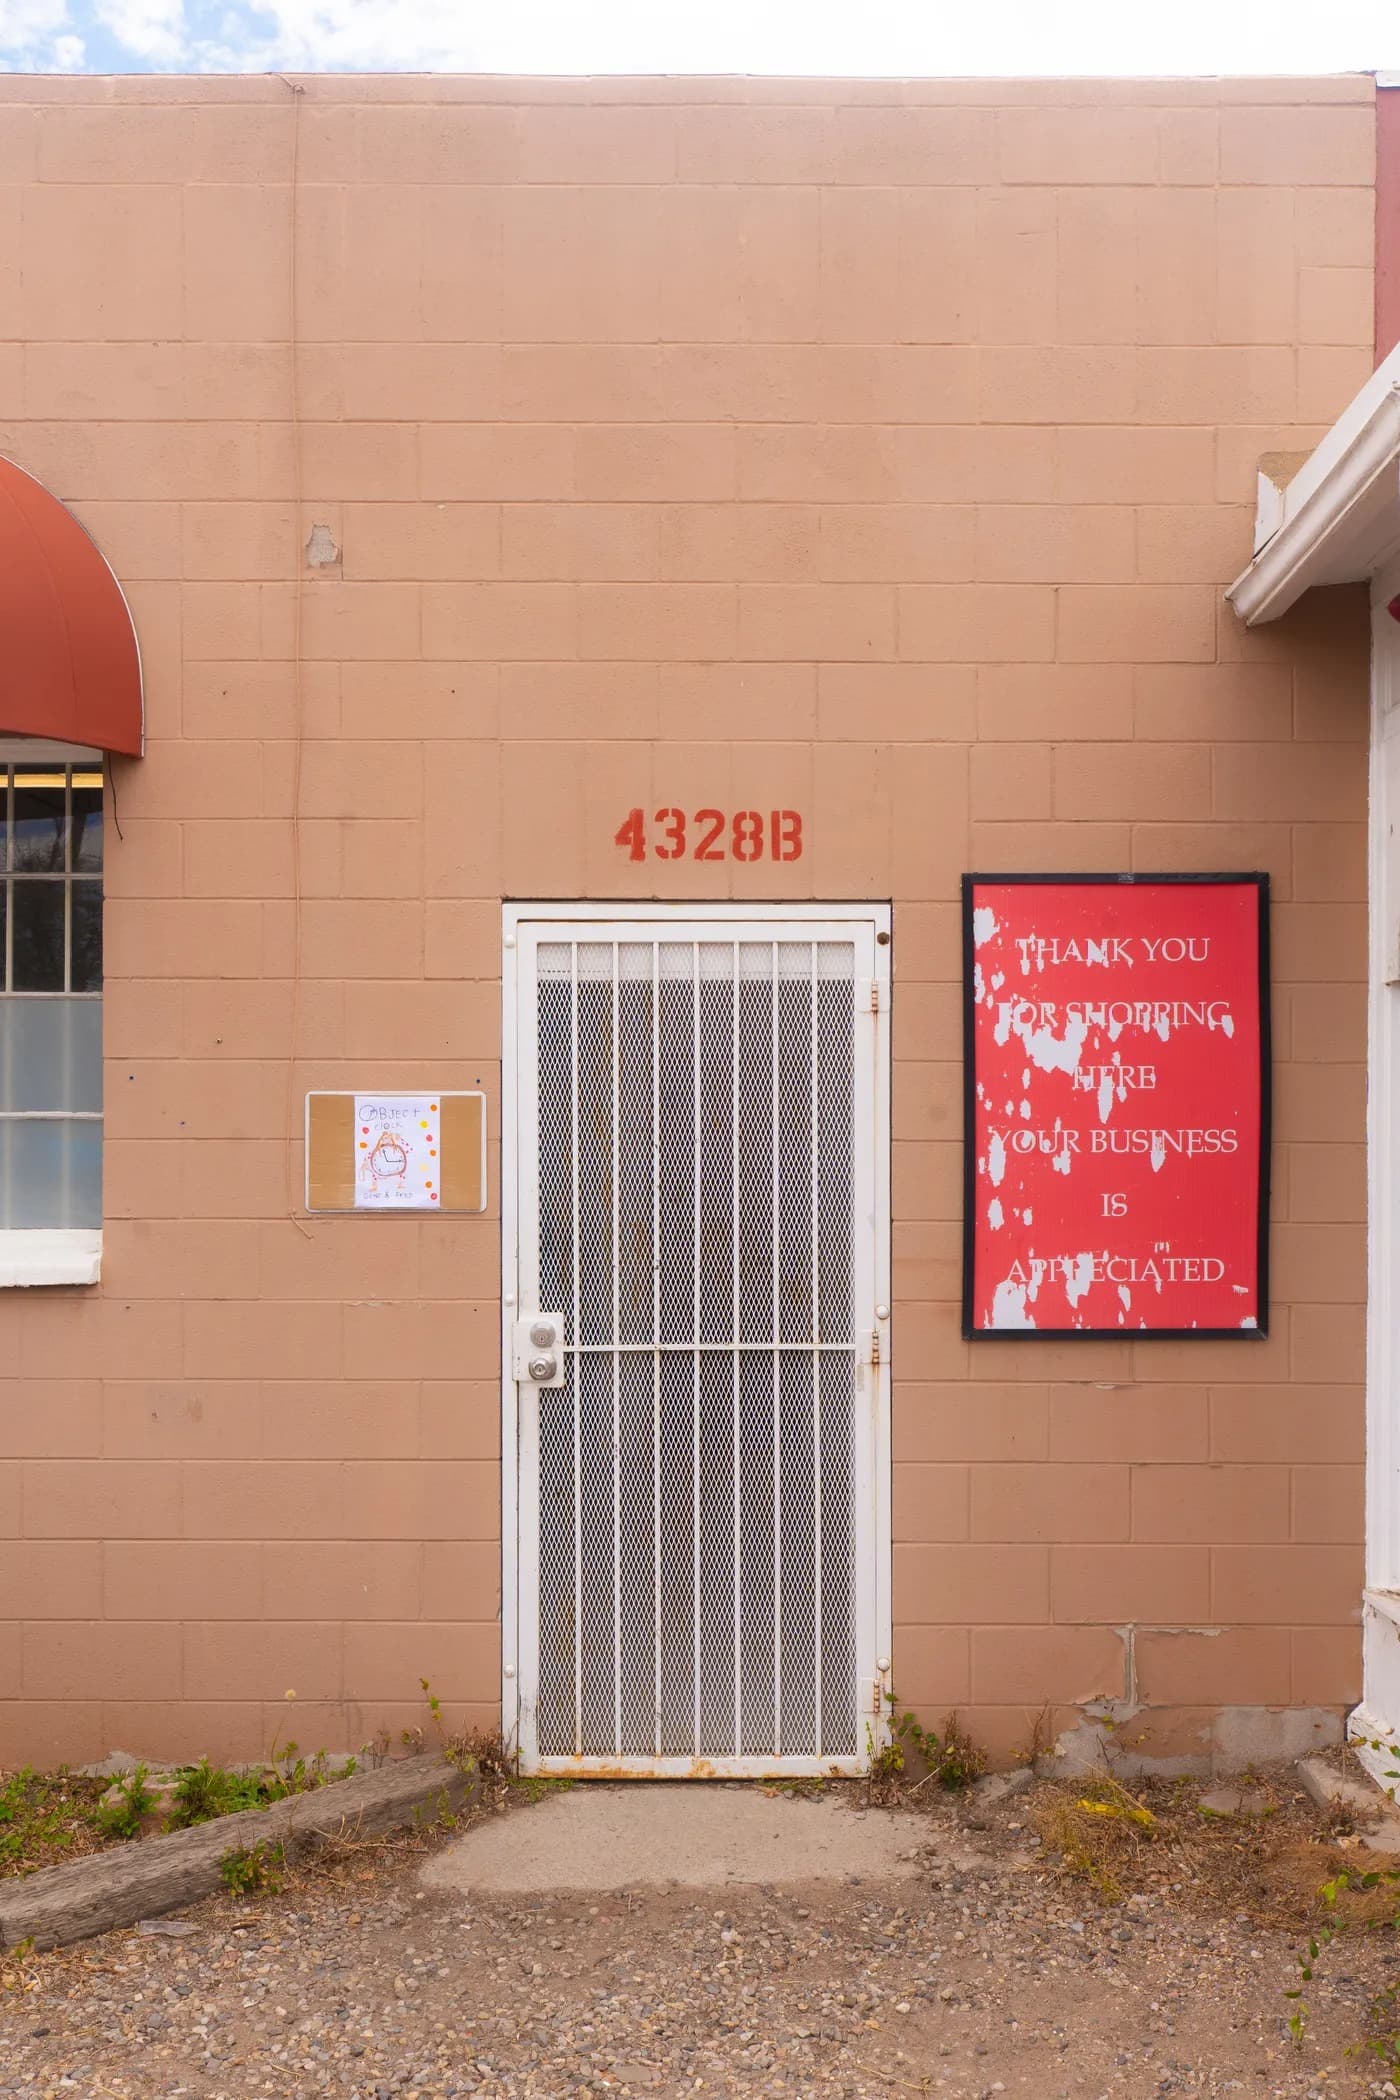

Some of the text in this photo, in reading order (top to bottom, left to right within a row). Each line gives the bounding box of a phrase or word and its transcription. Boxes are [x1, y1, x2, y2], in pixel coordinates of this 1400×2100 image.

[614, 807, 803, 862] 4328B
[1015, 937, 1211, 963] THANK YOU
[1066, 1001, 1232, 1028] SHOPPING
[1072, 1065, 1156, 1090] HERE
[989, 1129, 1239, 1154] YOUR BUSINESS
[1101, 1193, 1129, 1217] IS
